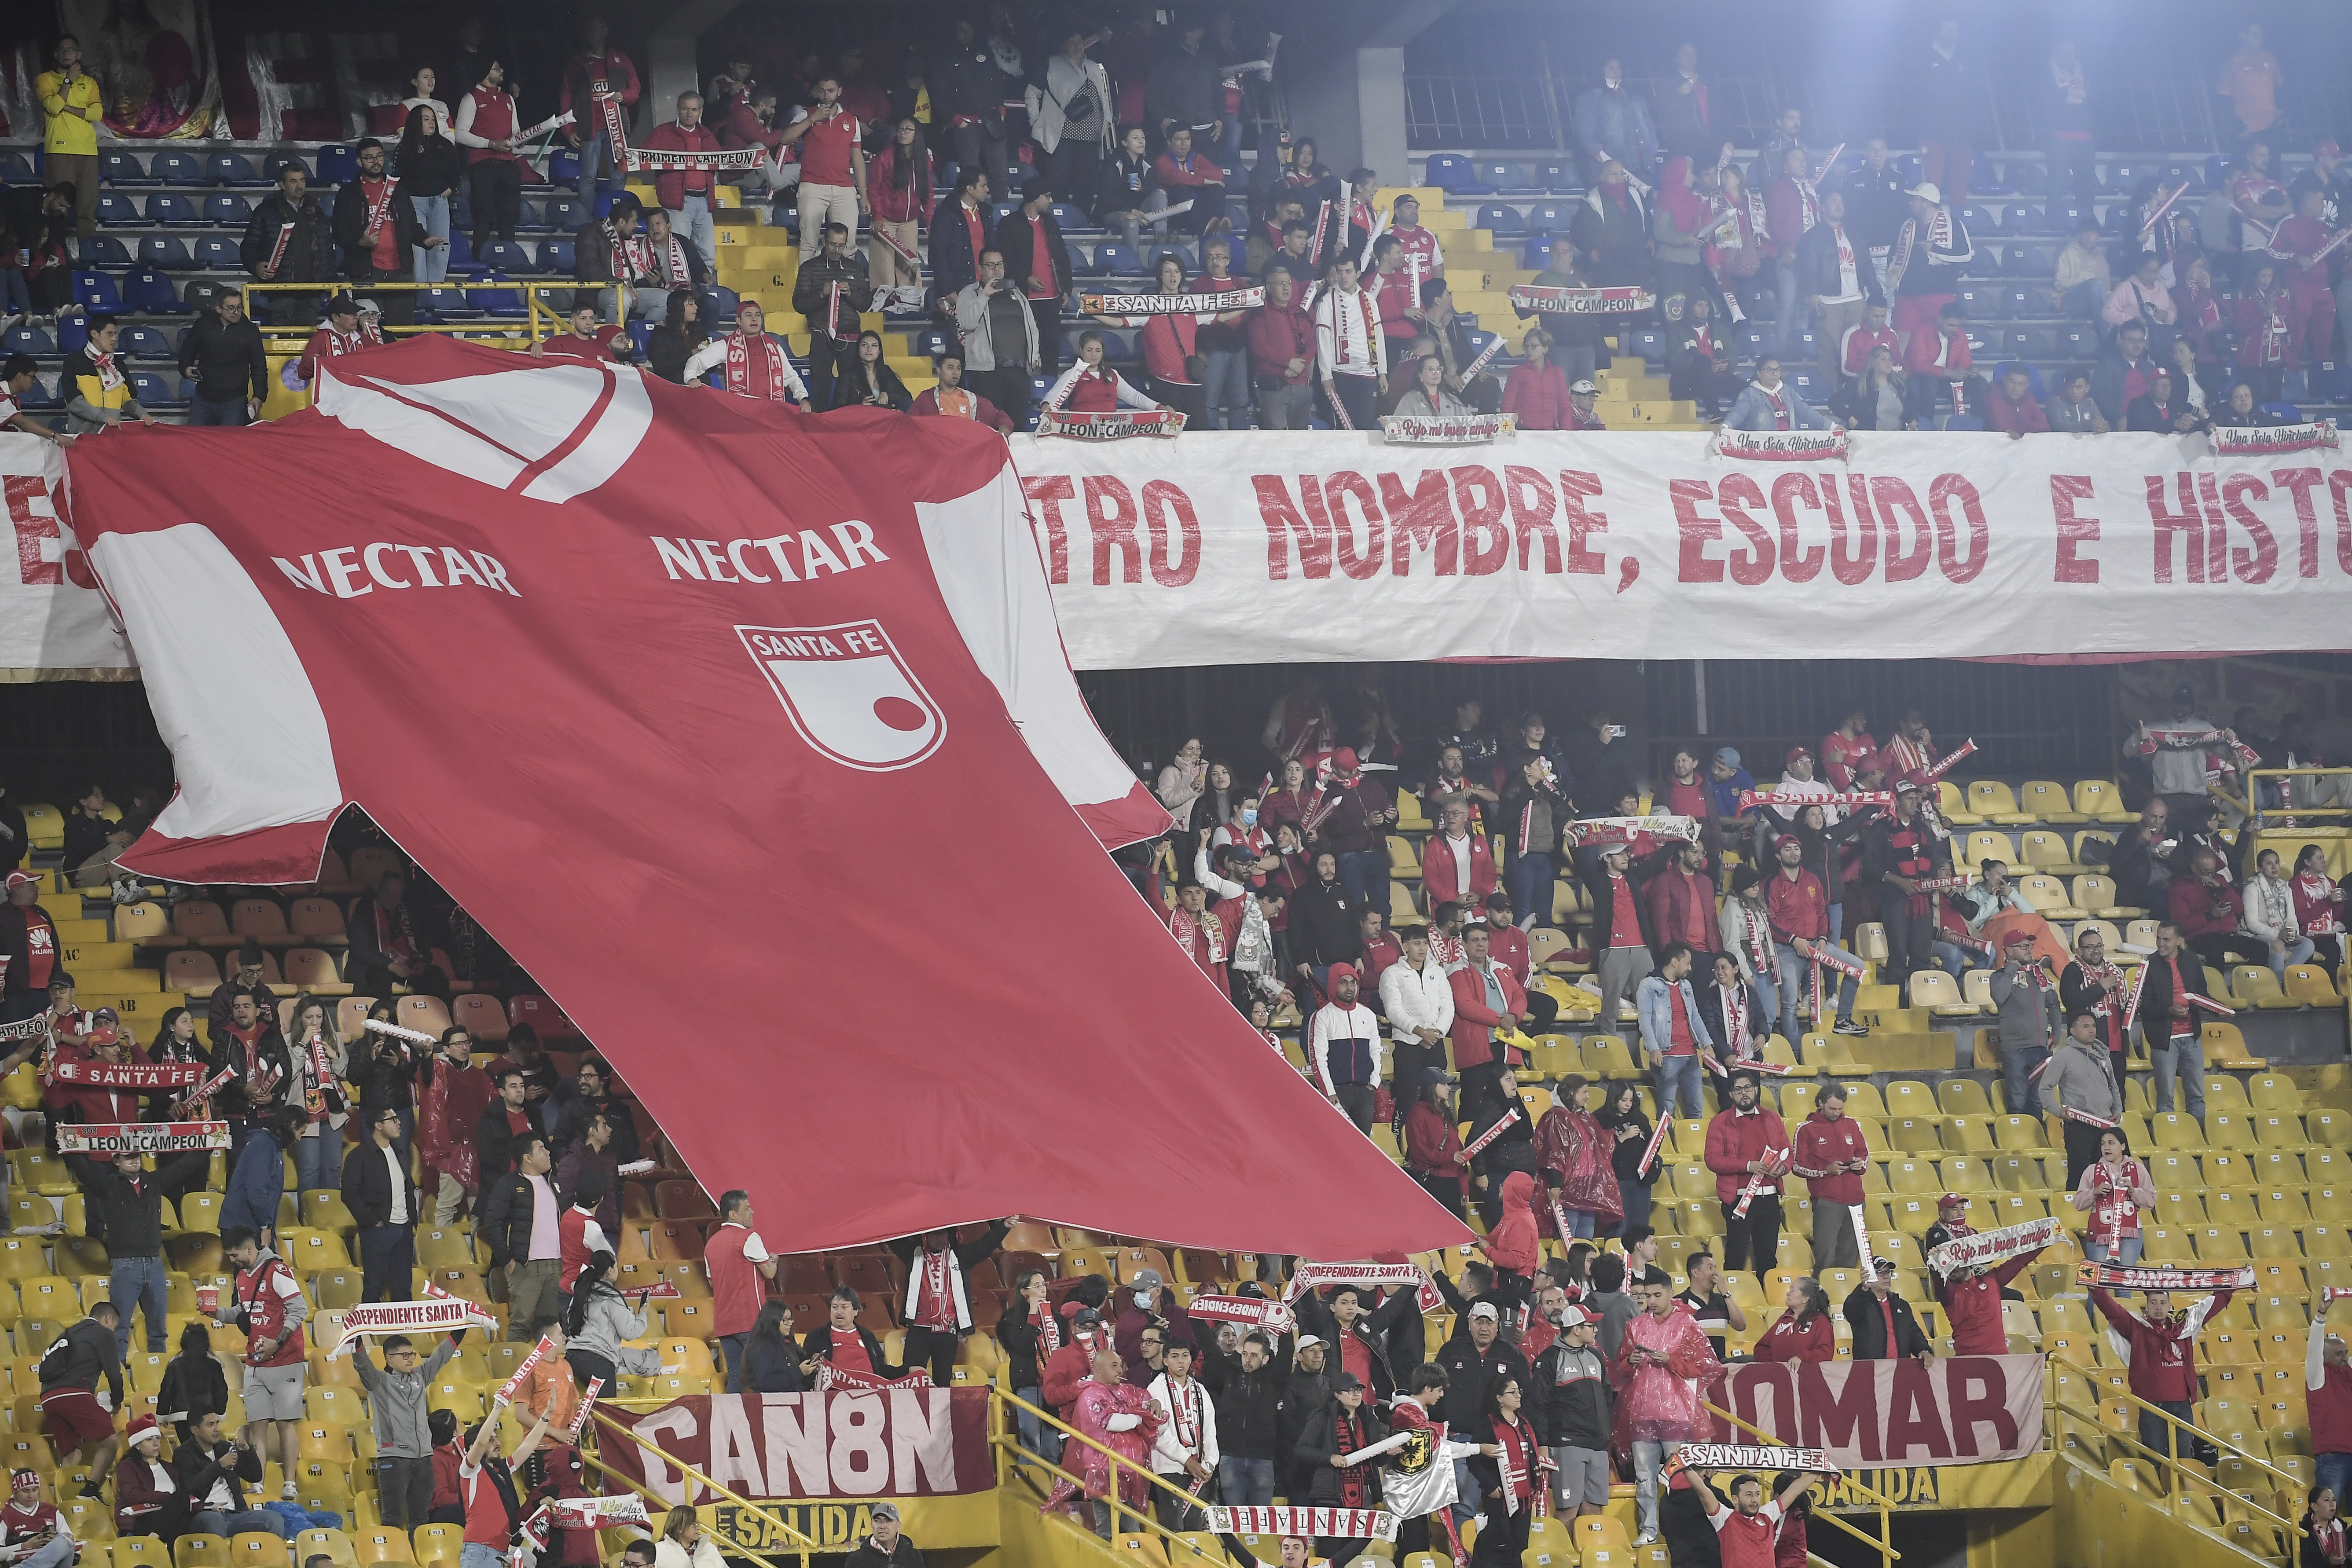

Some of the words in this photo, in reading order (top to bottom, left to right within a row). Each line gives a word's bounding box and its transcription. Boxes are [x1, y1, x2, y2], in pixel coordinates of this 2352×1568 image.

[514, 124, 543, 142] NECTAR
[607, 106, 621, 143] NECTAR
[640, 152, 686, 165] PRIMER
[695, 151, 752, 165] CAMPEON
[374, 196, 391, 230] NECTAR
[1317, 221, 1328, 255] NECTAR
[1117, 296, 1196, 313] SANTA
[1203, 293, 1231, 309] FE
[1529, 296, 1567, 312] LEÓN
[1574, 296, 1635, 312] CAMPEÓN
[1469, 348, 1496, 376] NECTAR
[1052, 379, 1076, 410] NECTAR
[1059, 421, 1097, 437] LEÓN
[1105, 420, 1163, 437] CAMPEÓN
[1402, 419, 1426, 436] Rojo
[1428, 422, 1442, 434] mi
[1468, 422, 1499, 437] amigo
[2225, 429, 2247, 445] Una
[1736, 433, 1760, 450] Una
[1791, 434, 1836, 452] Hinchada
[1250, 464, 1640, 595] NOMBRE,
[1668, 472, 1990, 586] ESCUDO
[2050, 474, 2101, 584] E
[649, 520, 891, 584] NECTAR
[270, 542, 523, 599] NECTAR
[751, 634, 839, 657] SANTA
[848, 629, 884, 654] FE
[1934, 749, 1962, 774] NECTAR
[1773, 791, 1846, 805] SANTA
[1847, 790, 1875, 804] FE
[1301, 798, 1316, 824] NECTAR
[2282, 798, 2295, 829] NETAR
[1921, 877, 1952, 889] NECTAR
[63, 949, 80, 961] AC
[1813, 948, 1847, 971] NECTAR
[117, 999, 136, 1012] AB
[2126, 982, 2140, 1015] NECTAR
[0, 1020, 47, 1040] AMPEÓ
[317, 1043, 329, 1073] NECTAR
[90, 1070, 159, 1085] SANTA
[170, 1070, 195, 1083] FE
[189, 1080, 220, 1110] NECTAR
[2076, 1115, 2102, 1128] NECTAR
[88, 1134, 131, 1151] LEÓN
[140, 1134, 208, 1150] CAMPEÓN
[1471, 1128, 1502, 1156] NECTAR
[2113, 1202, 2123, 1238] NECTAR
[1950, 1241, 1977, 1262] Rojo
[1978, 1242, 1993, 1255] mi
[1993, 1235, 2019, 1253] buen
[2019, 1229, 2051, 1249] amigo
[1304, 1265, 1377, 1279] INDEPENDIENTE
[1378, 1264, 1411, 1277] SANTA
[2122, 1270, 2186, 1287] SANTA
[2189, 1271, 2216, 1287] FE
[344, 1305, 424, 1331] INDEPENDIENTE
[426, 1303, 464, 1320] SANTA
[1191, 1298, 1261, 1318] INDEPENDIEN
[1044, 1314, 1060, 1352] NECTAR
[514, 1349, 544, 1383] NECTAR
[1693, 1445, 1780, 1466] SANTA
[1781, 1447, 1812, 1468] FE
[1505, 1464, 1517, 1495] NECTAR
[597, 1499, 624, 1514] Miles
[736, 1506, 873, 1547] SALIDA
[1238, 1512, 1269, 1527] FE
[1278, 1513, 1368, 1531] SANTA
